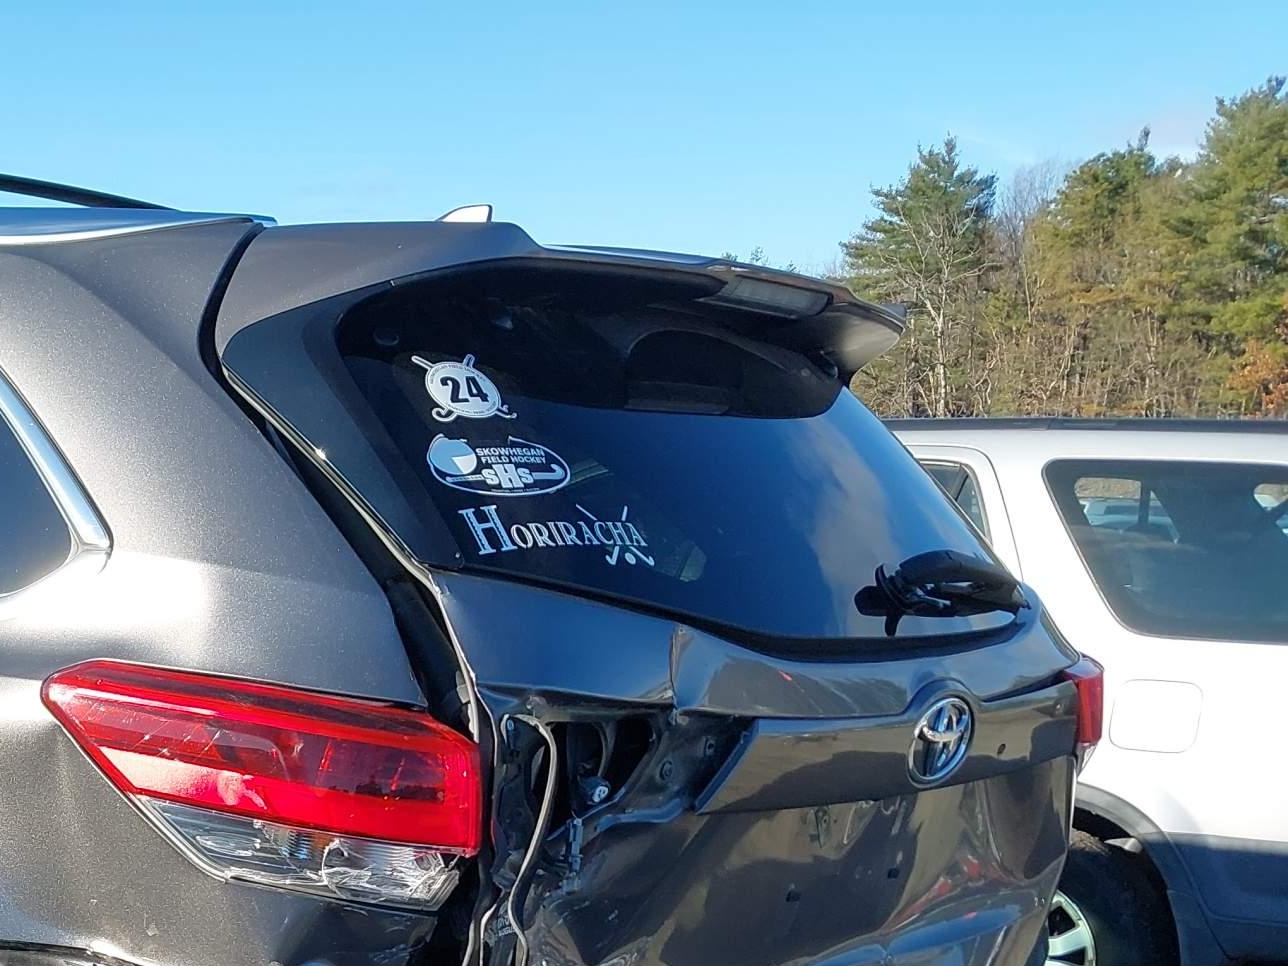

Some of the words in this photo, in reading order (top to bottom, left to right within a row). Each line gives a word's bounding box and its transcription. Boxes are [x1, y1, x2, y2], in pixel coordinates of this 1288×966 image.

[440, 375, 489, 403] 24
[475, 447, 545, 457] SKOWHEGAN
[481, 456, 510, 464] FIELD
[511, 456, 546, 465] HOCKEY
